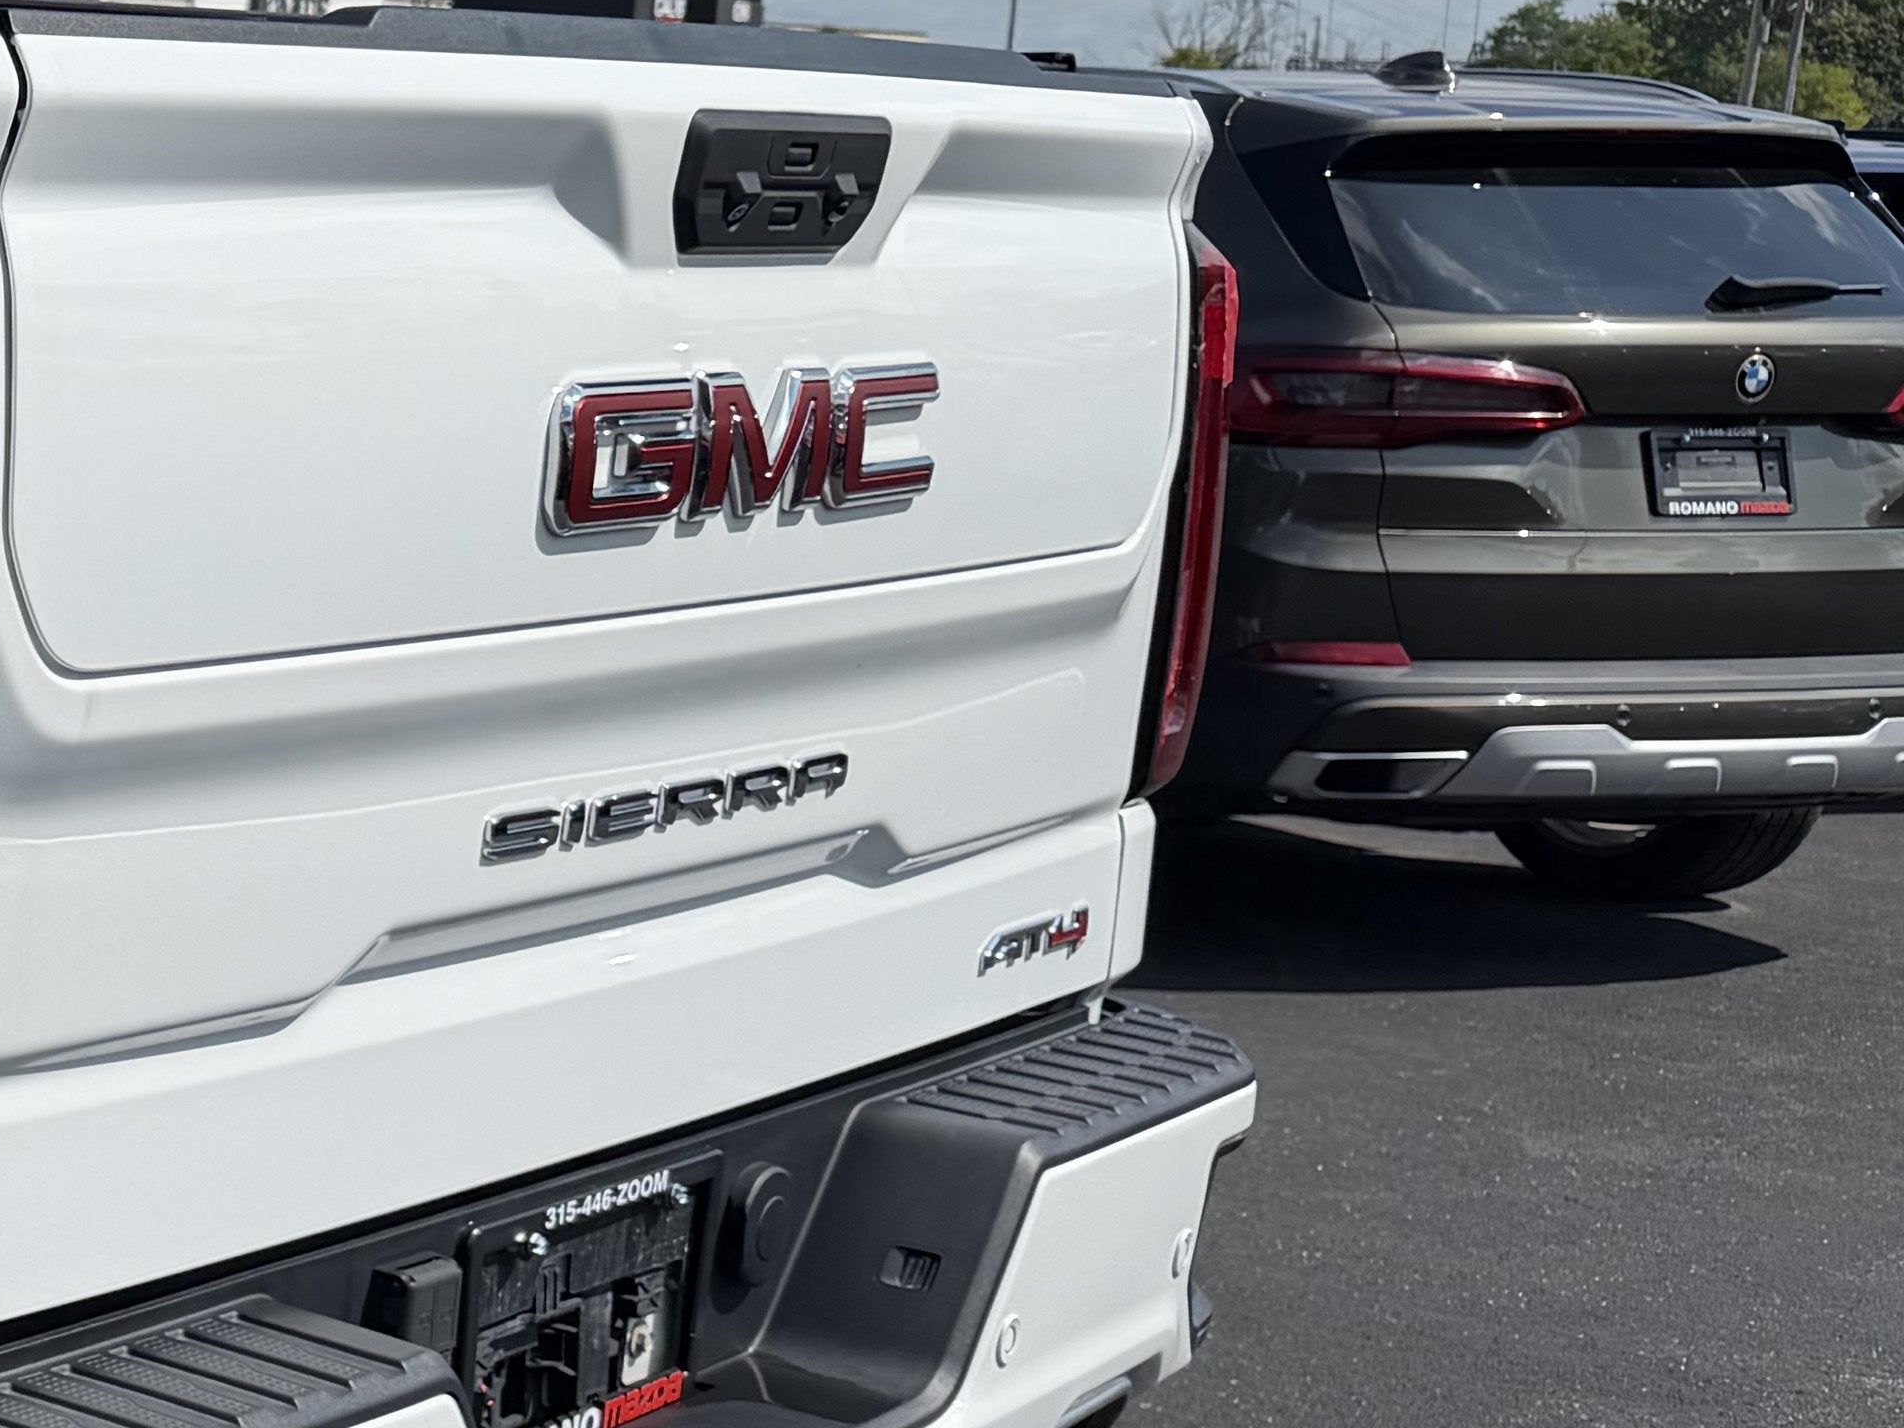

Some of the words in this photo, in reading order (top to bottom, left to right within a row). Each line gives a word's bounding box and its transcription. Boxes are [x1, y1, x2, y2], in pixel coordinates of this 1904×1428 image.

[540, 361, 940, 538] GMC
[1668, 500, 1739, 515] ROMANO
[479, 751, 850, 866] SIERRA
[976, 901, 1090, 977] AT4
[544, 1169, 670, 1230] 315-446-ZOOM
